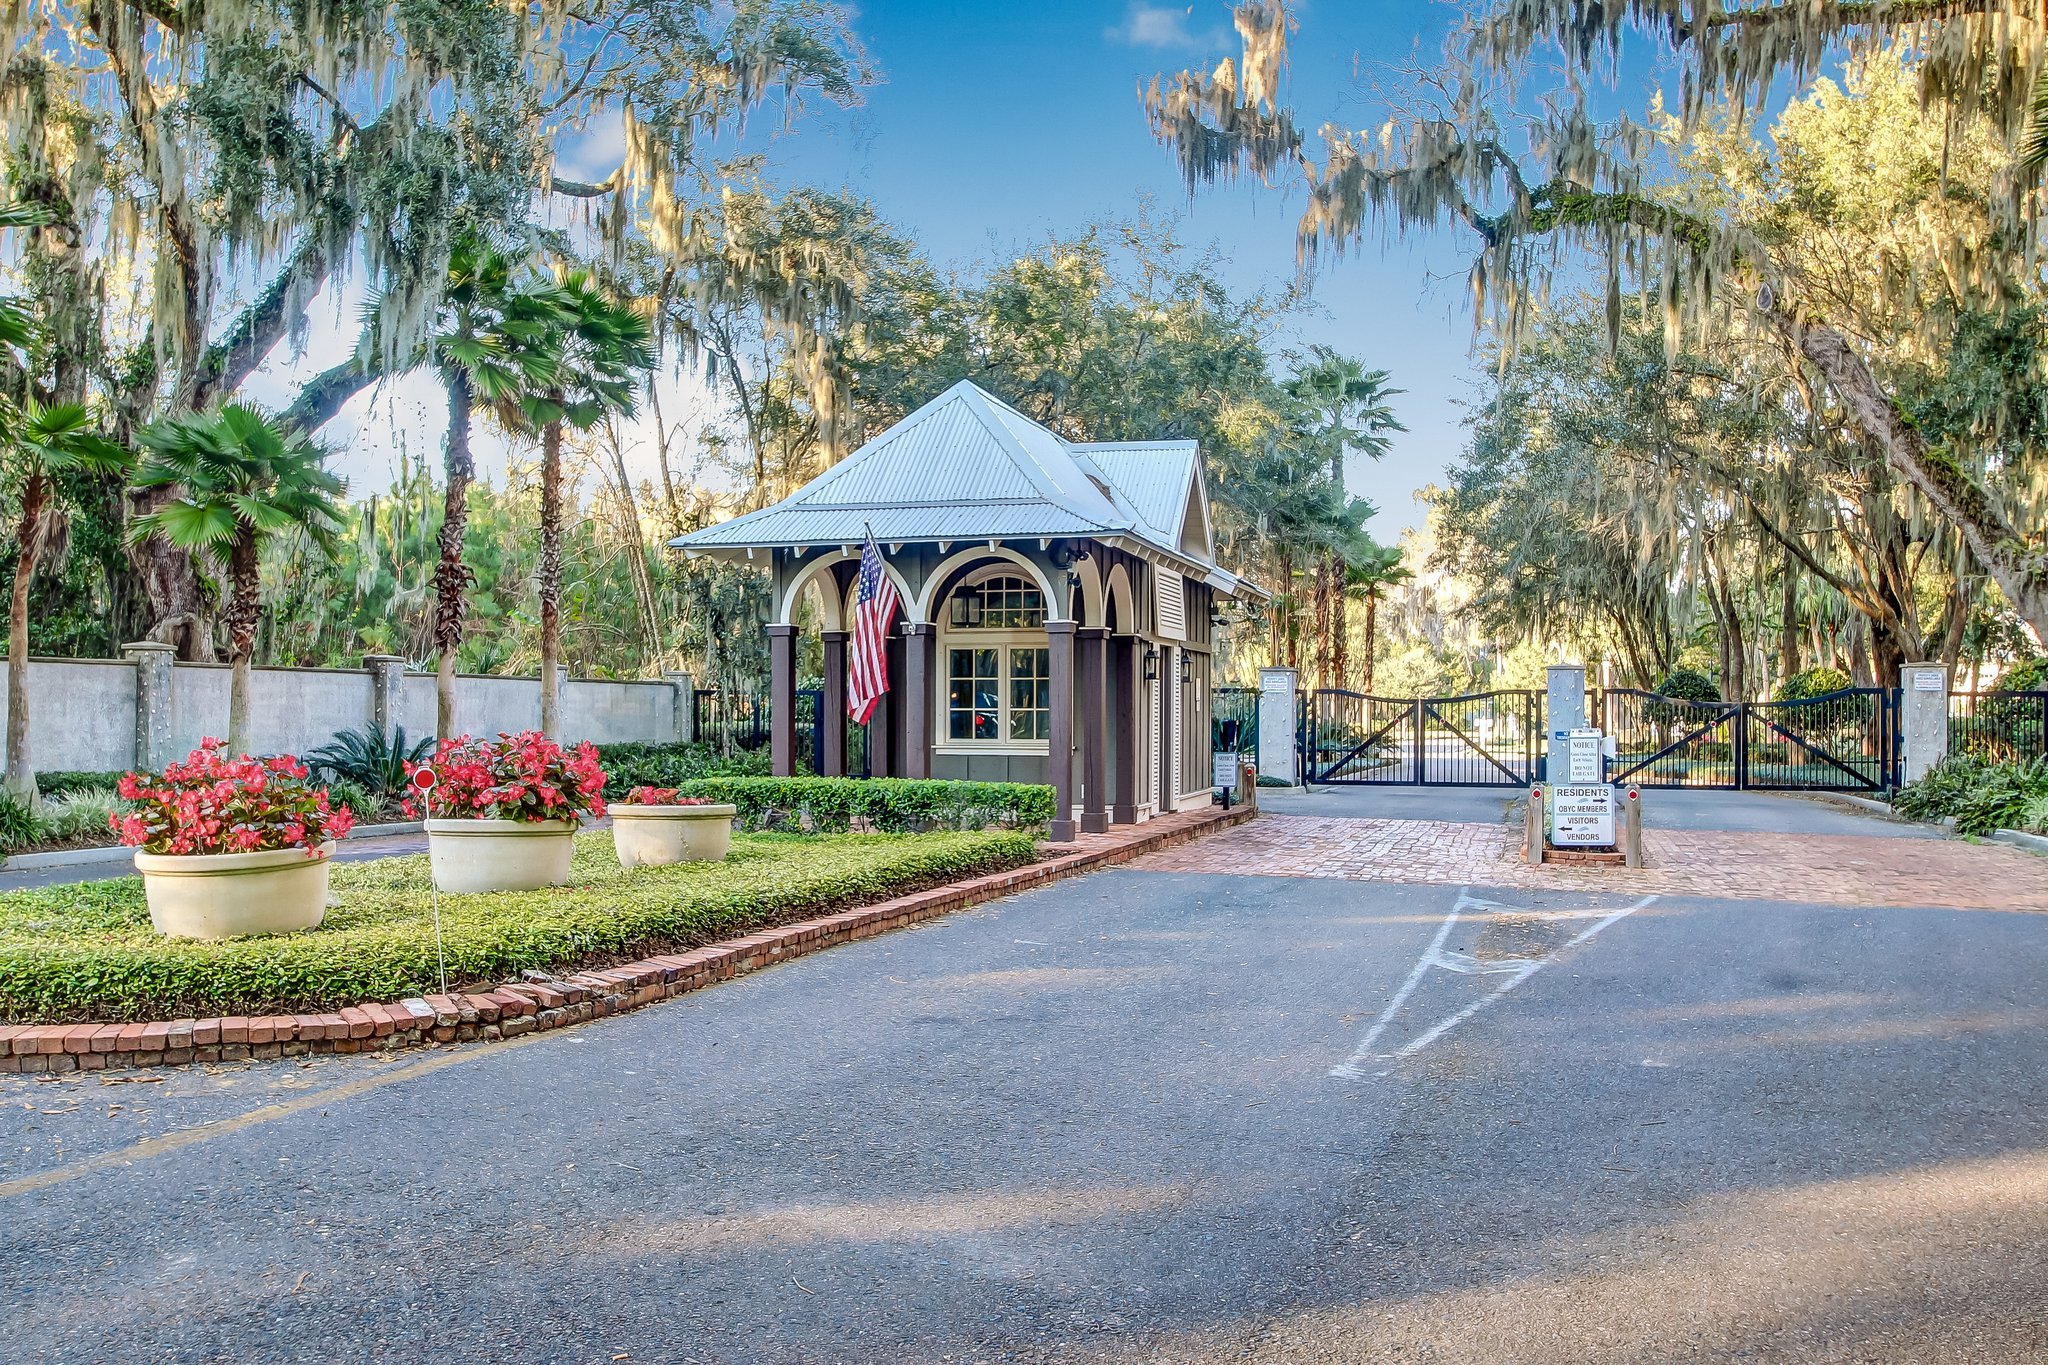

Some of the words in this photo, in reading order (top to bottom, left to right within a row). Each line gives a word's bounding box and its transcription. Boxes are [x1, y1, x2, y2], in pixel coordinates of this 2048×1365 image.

[1557, 788, 1609, 797] RESIDENTS
[1567, 817, 1599, 825] VISITORS
[1566, 833, 1600, 841] VENDORS
